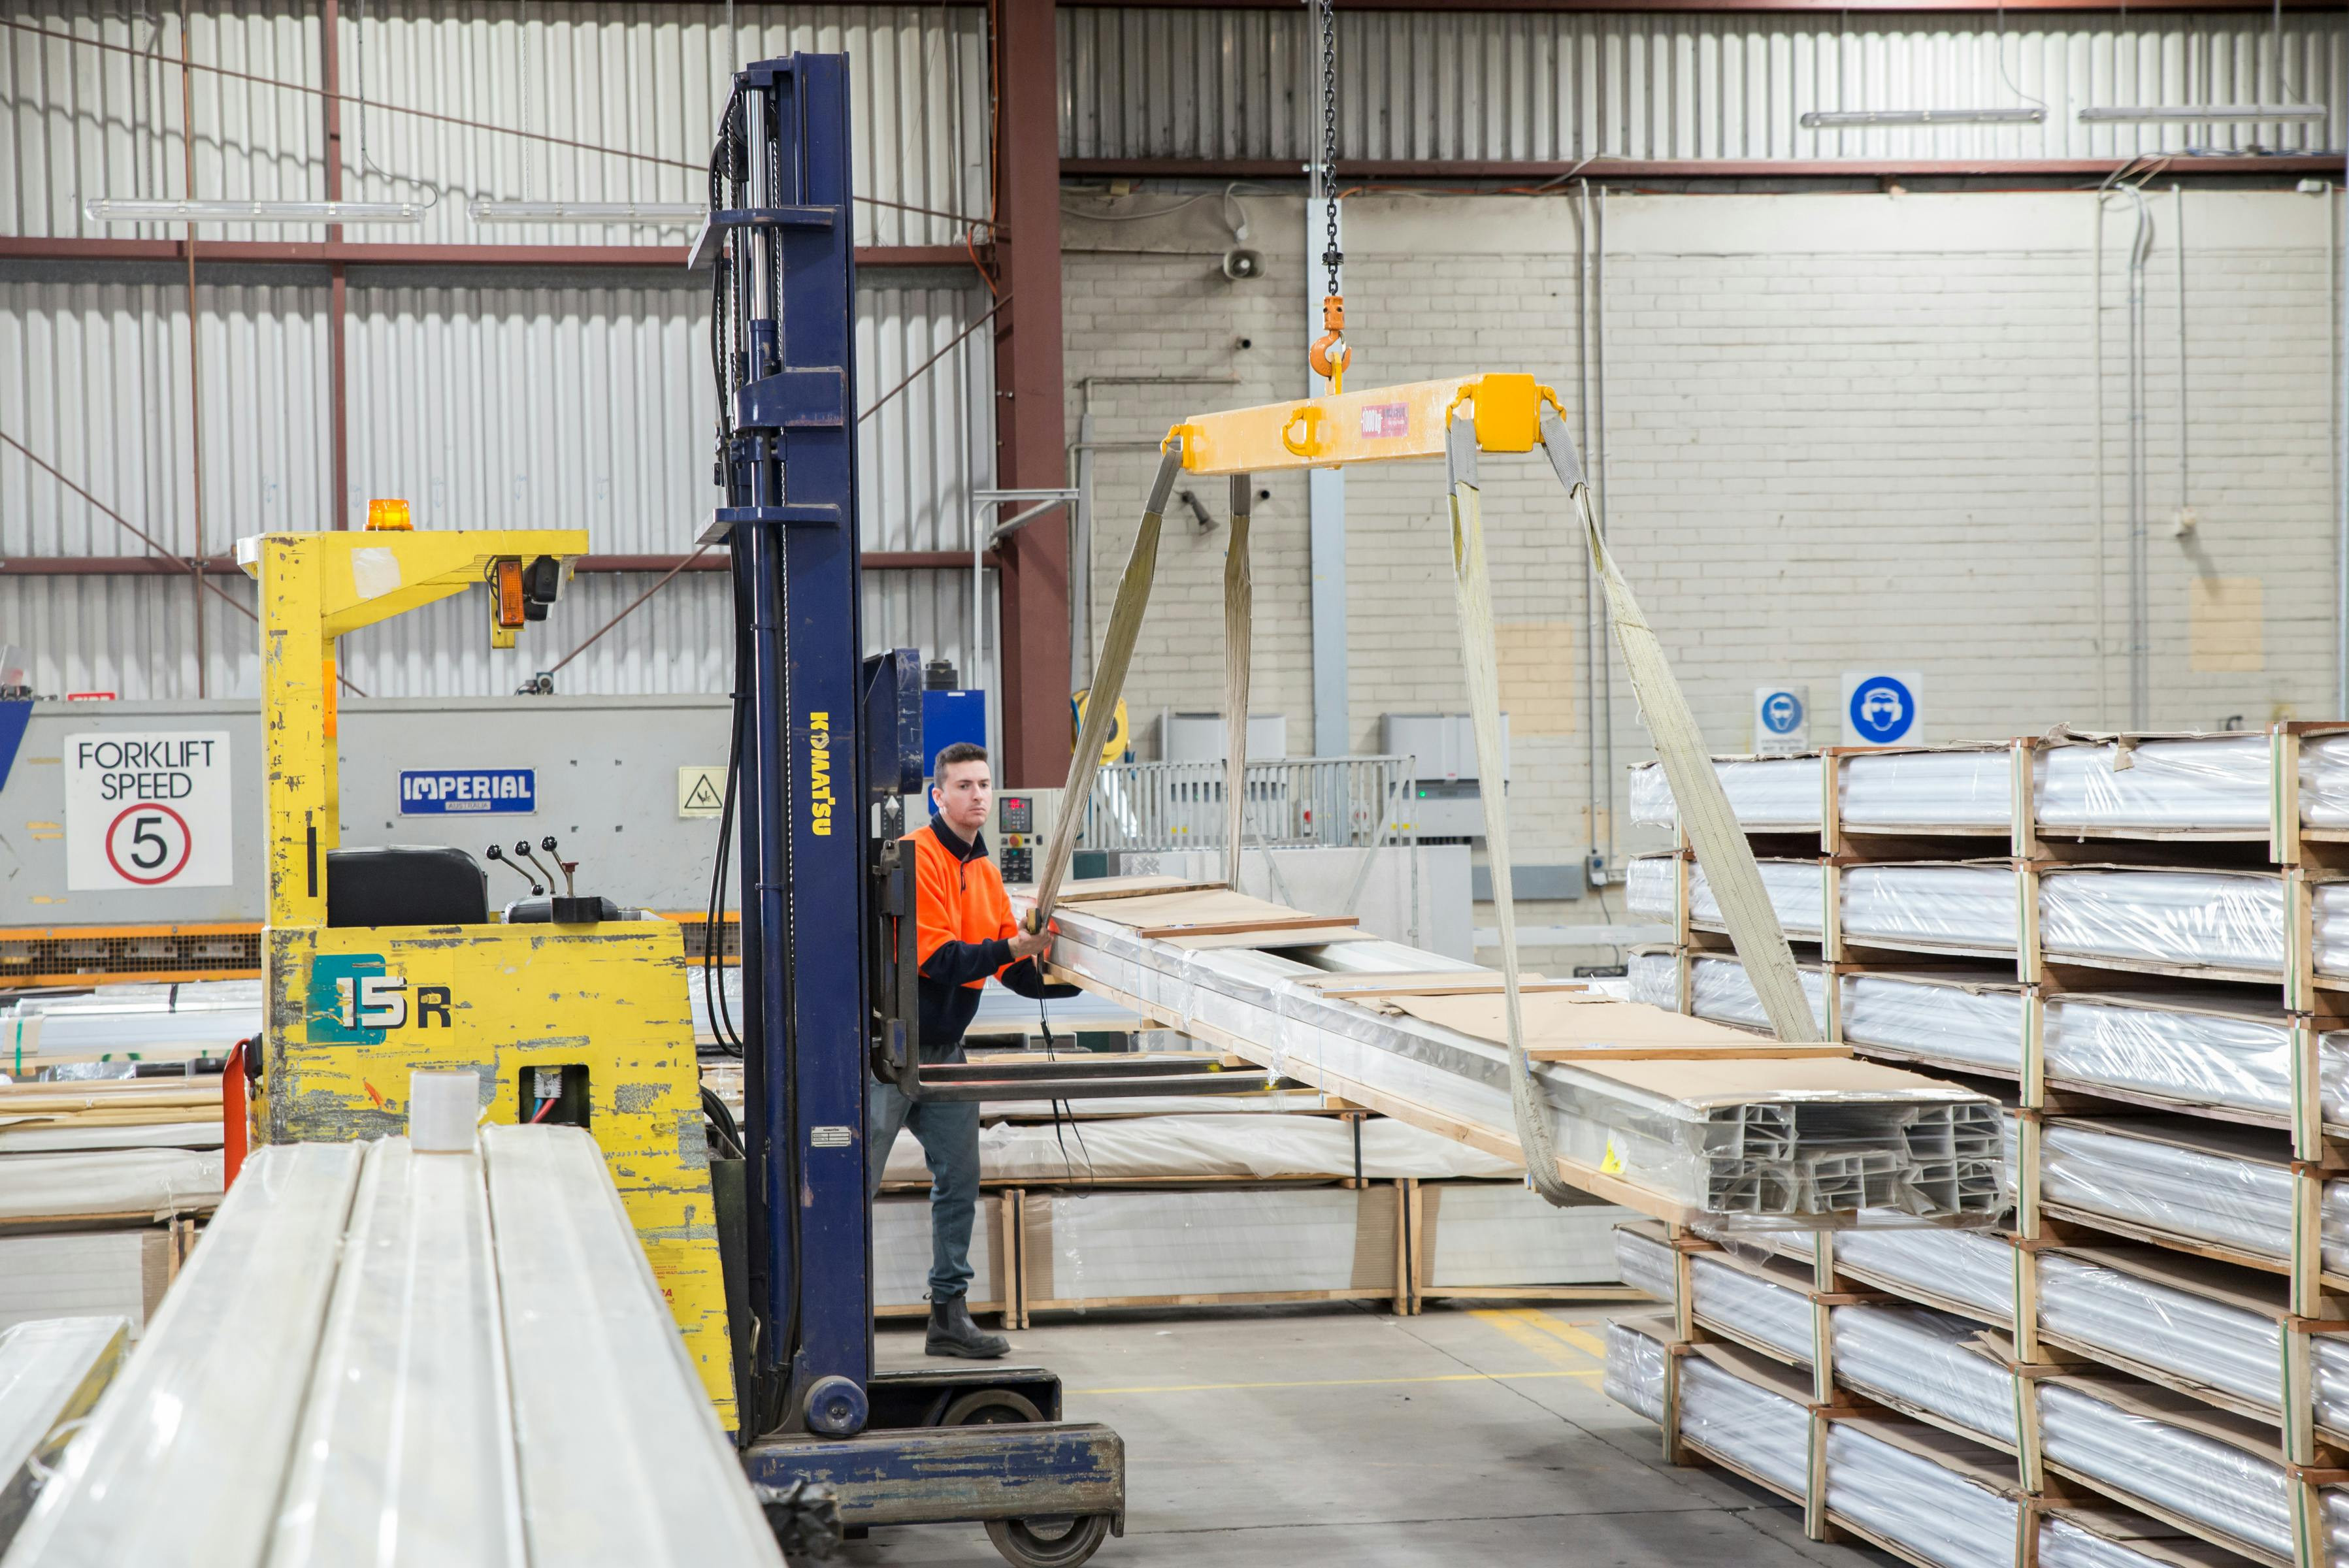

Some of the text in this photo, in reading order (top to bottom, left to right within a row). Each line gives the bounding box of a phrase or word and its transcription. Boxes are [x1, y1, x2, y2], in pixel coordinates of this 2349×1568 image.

[79, 741, 215, 769] FORKLIFT
[101, 772, 192, 800] SPEED
[810, 711, 836, 836] KOMATSU
[404, 776, 531, 800] IMPERIAL
[131, 817, 167, 868] 5
